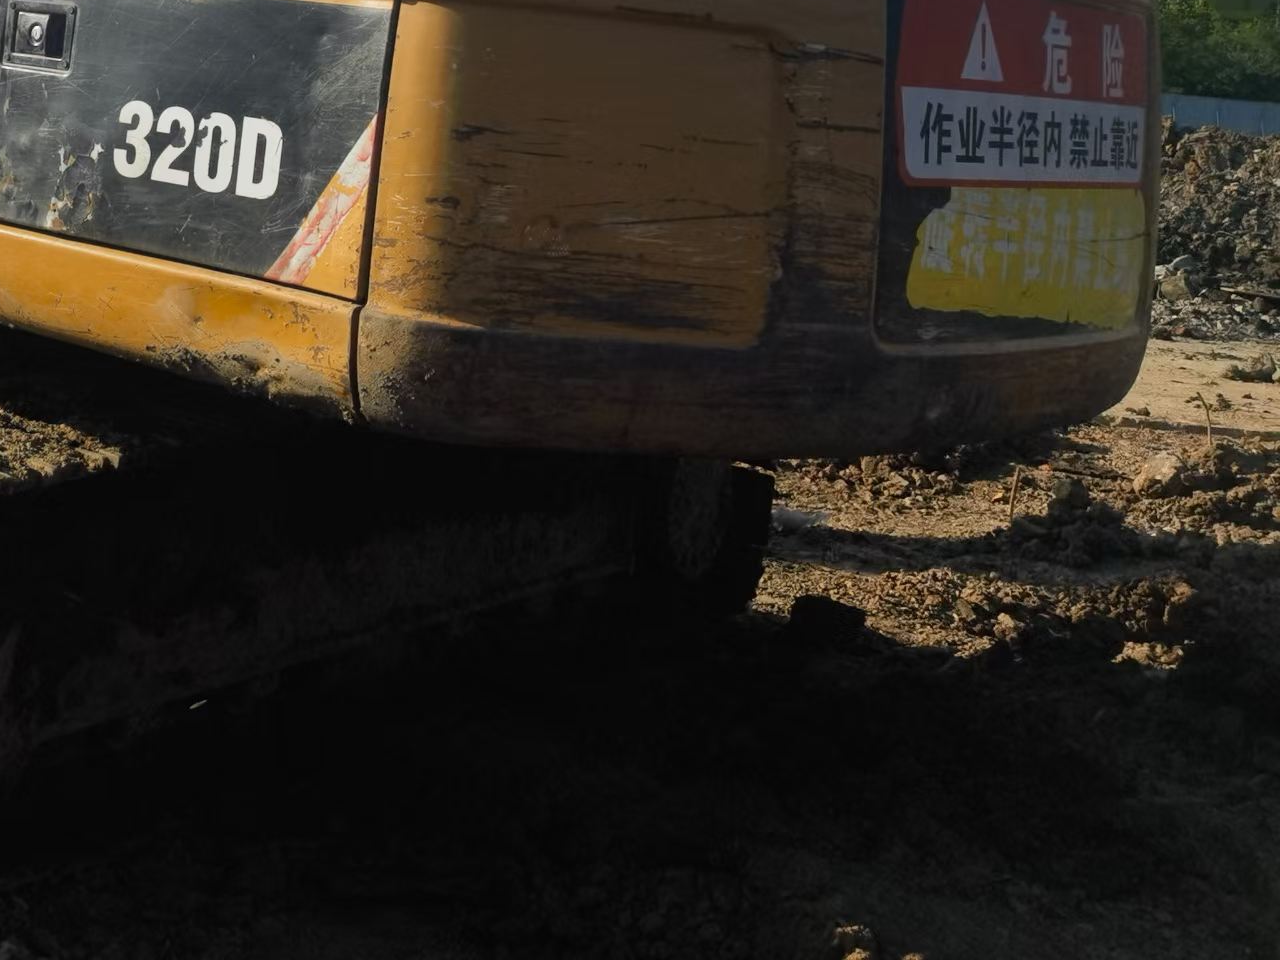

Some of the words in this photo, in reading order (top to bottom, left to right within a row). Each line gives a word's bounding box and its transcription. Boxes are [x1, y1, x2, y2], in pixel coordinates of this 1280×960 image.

[1042, 11, 1125, 98] 危险
[113, 100, 283, 200] 320D
[920, 101, 1138, 170] 作业半径内禁止靠近
